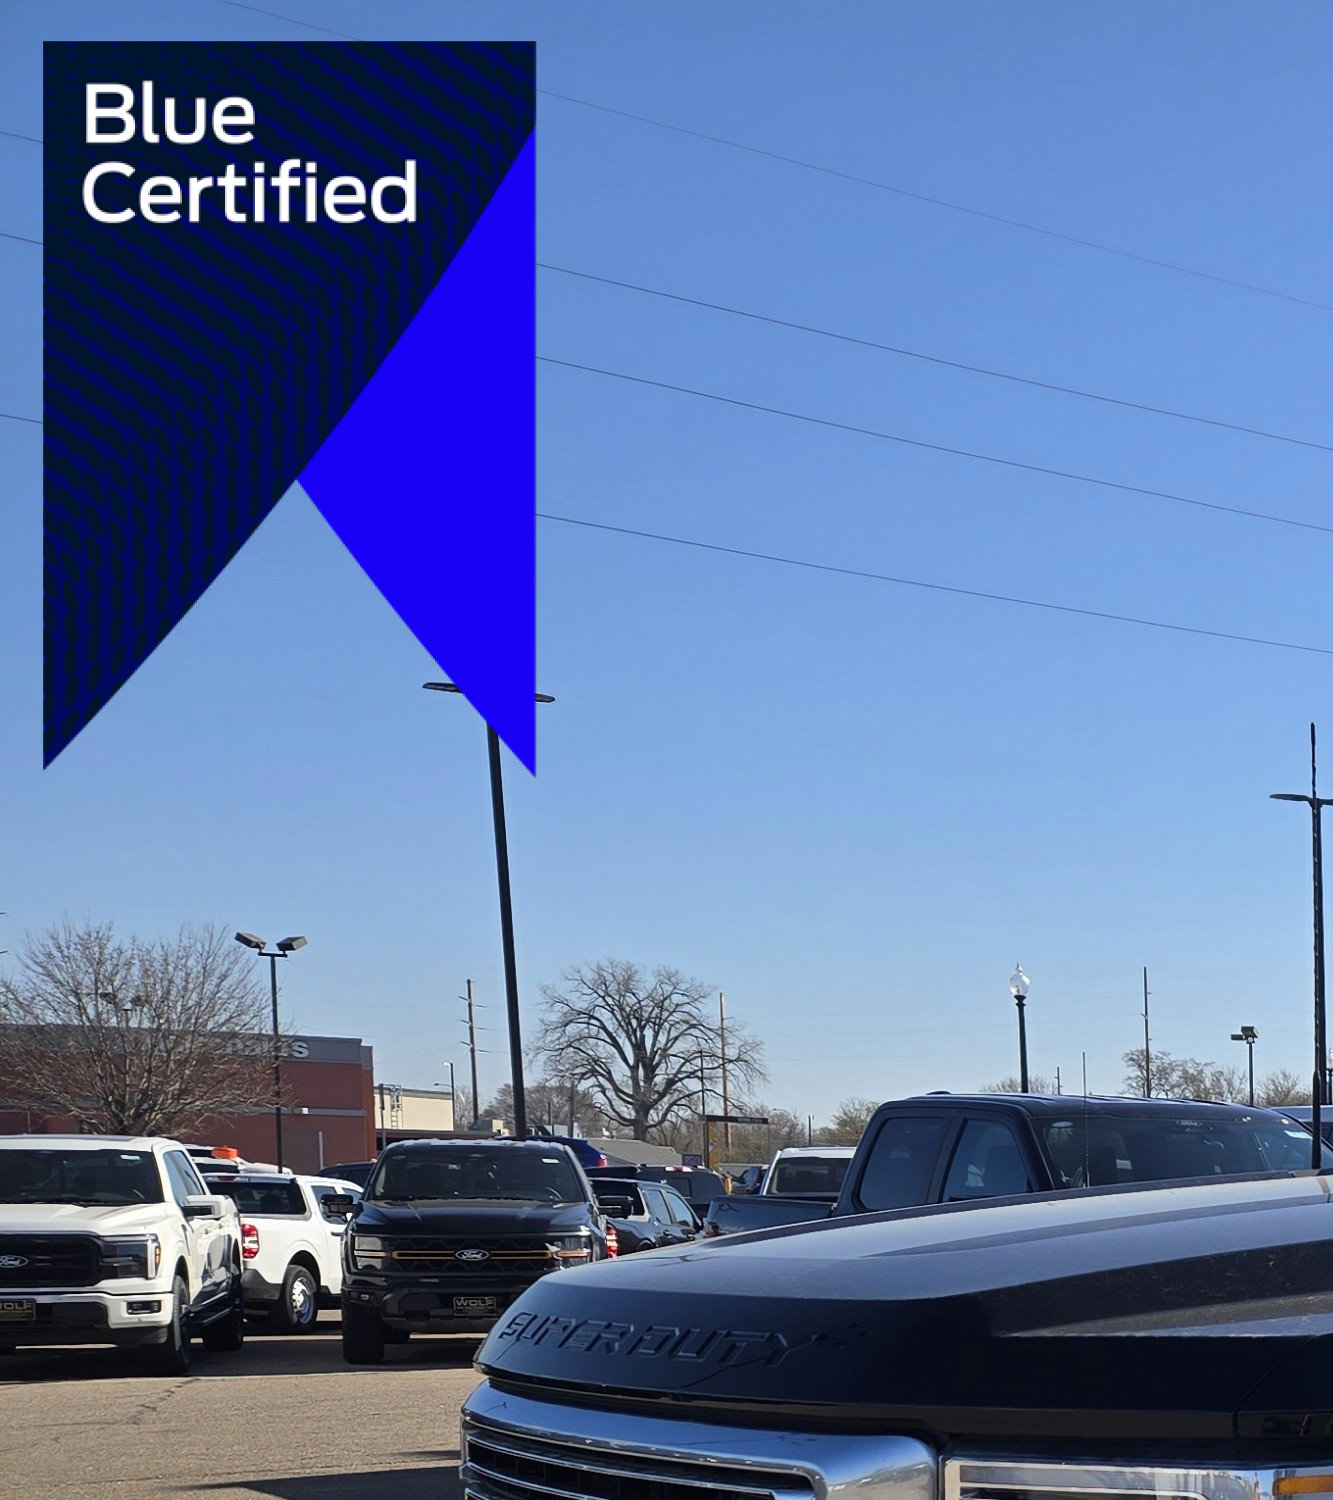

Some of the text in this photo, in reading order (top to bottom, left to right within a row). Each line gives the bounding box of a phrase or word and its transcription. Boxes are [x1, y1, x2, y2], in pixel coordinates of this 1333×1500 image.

[0, 1301, 33, 1310] OLF
[455, 1299, 494, 1307] WOLF
[499, 1311, 788, 1368] SUPER DUTY
